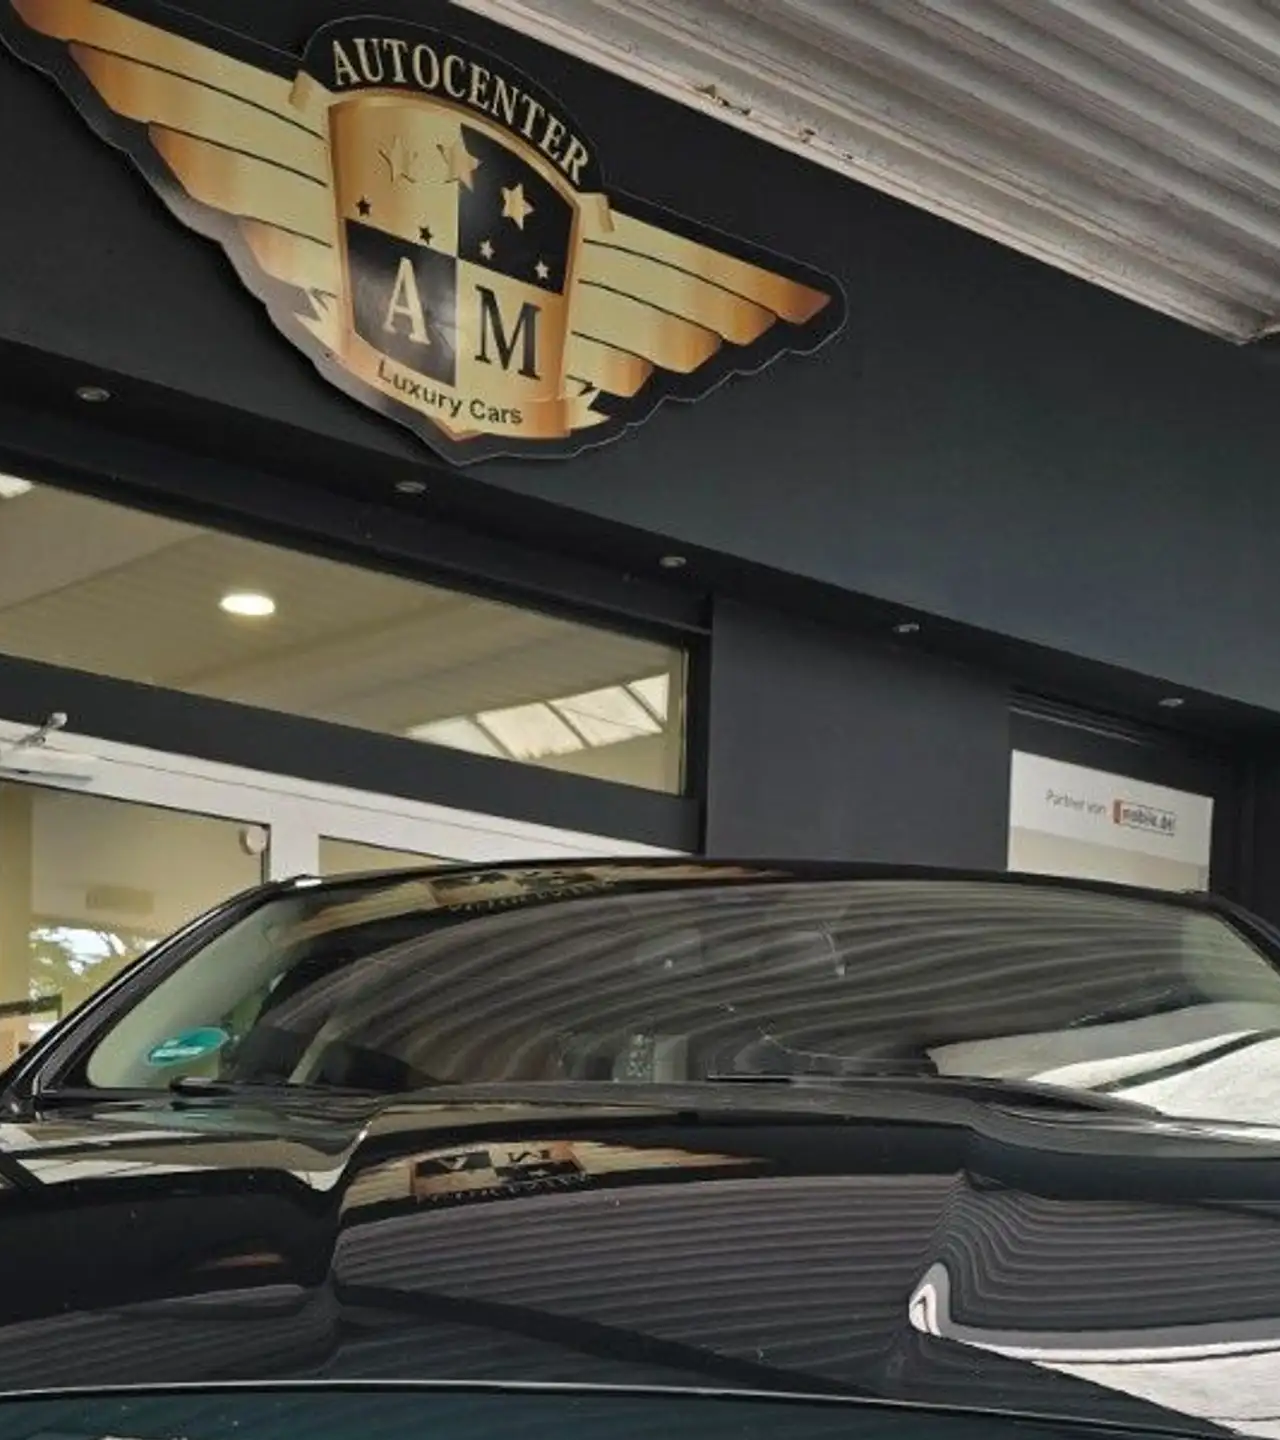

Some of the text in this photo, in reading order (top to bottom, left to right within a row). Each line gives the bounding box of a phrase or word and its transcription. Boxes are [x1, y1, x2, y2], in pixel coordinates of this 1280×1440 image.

[332, 37, 590, 186] AUTOCENTER
[384, 257, 541, 381] A M
[377, 360, 523, 426] Luxury Cars
